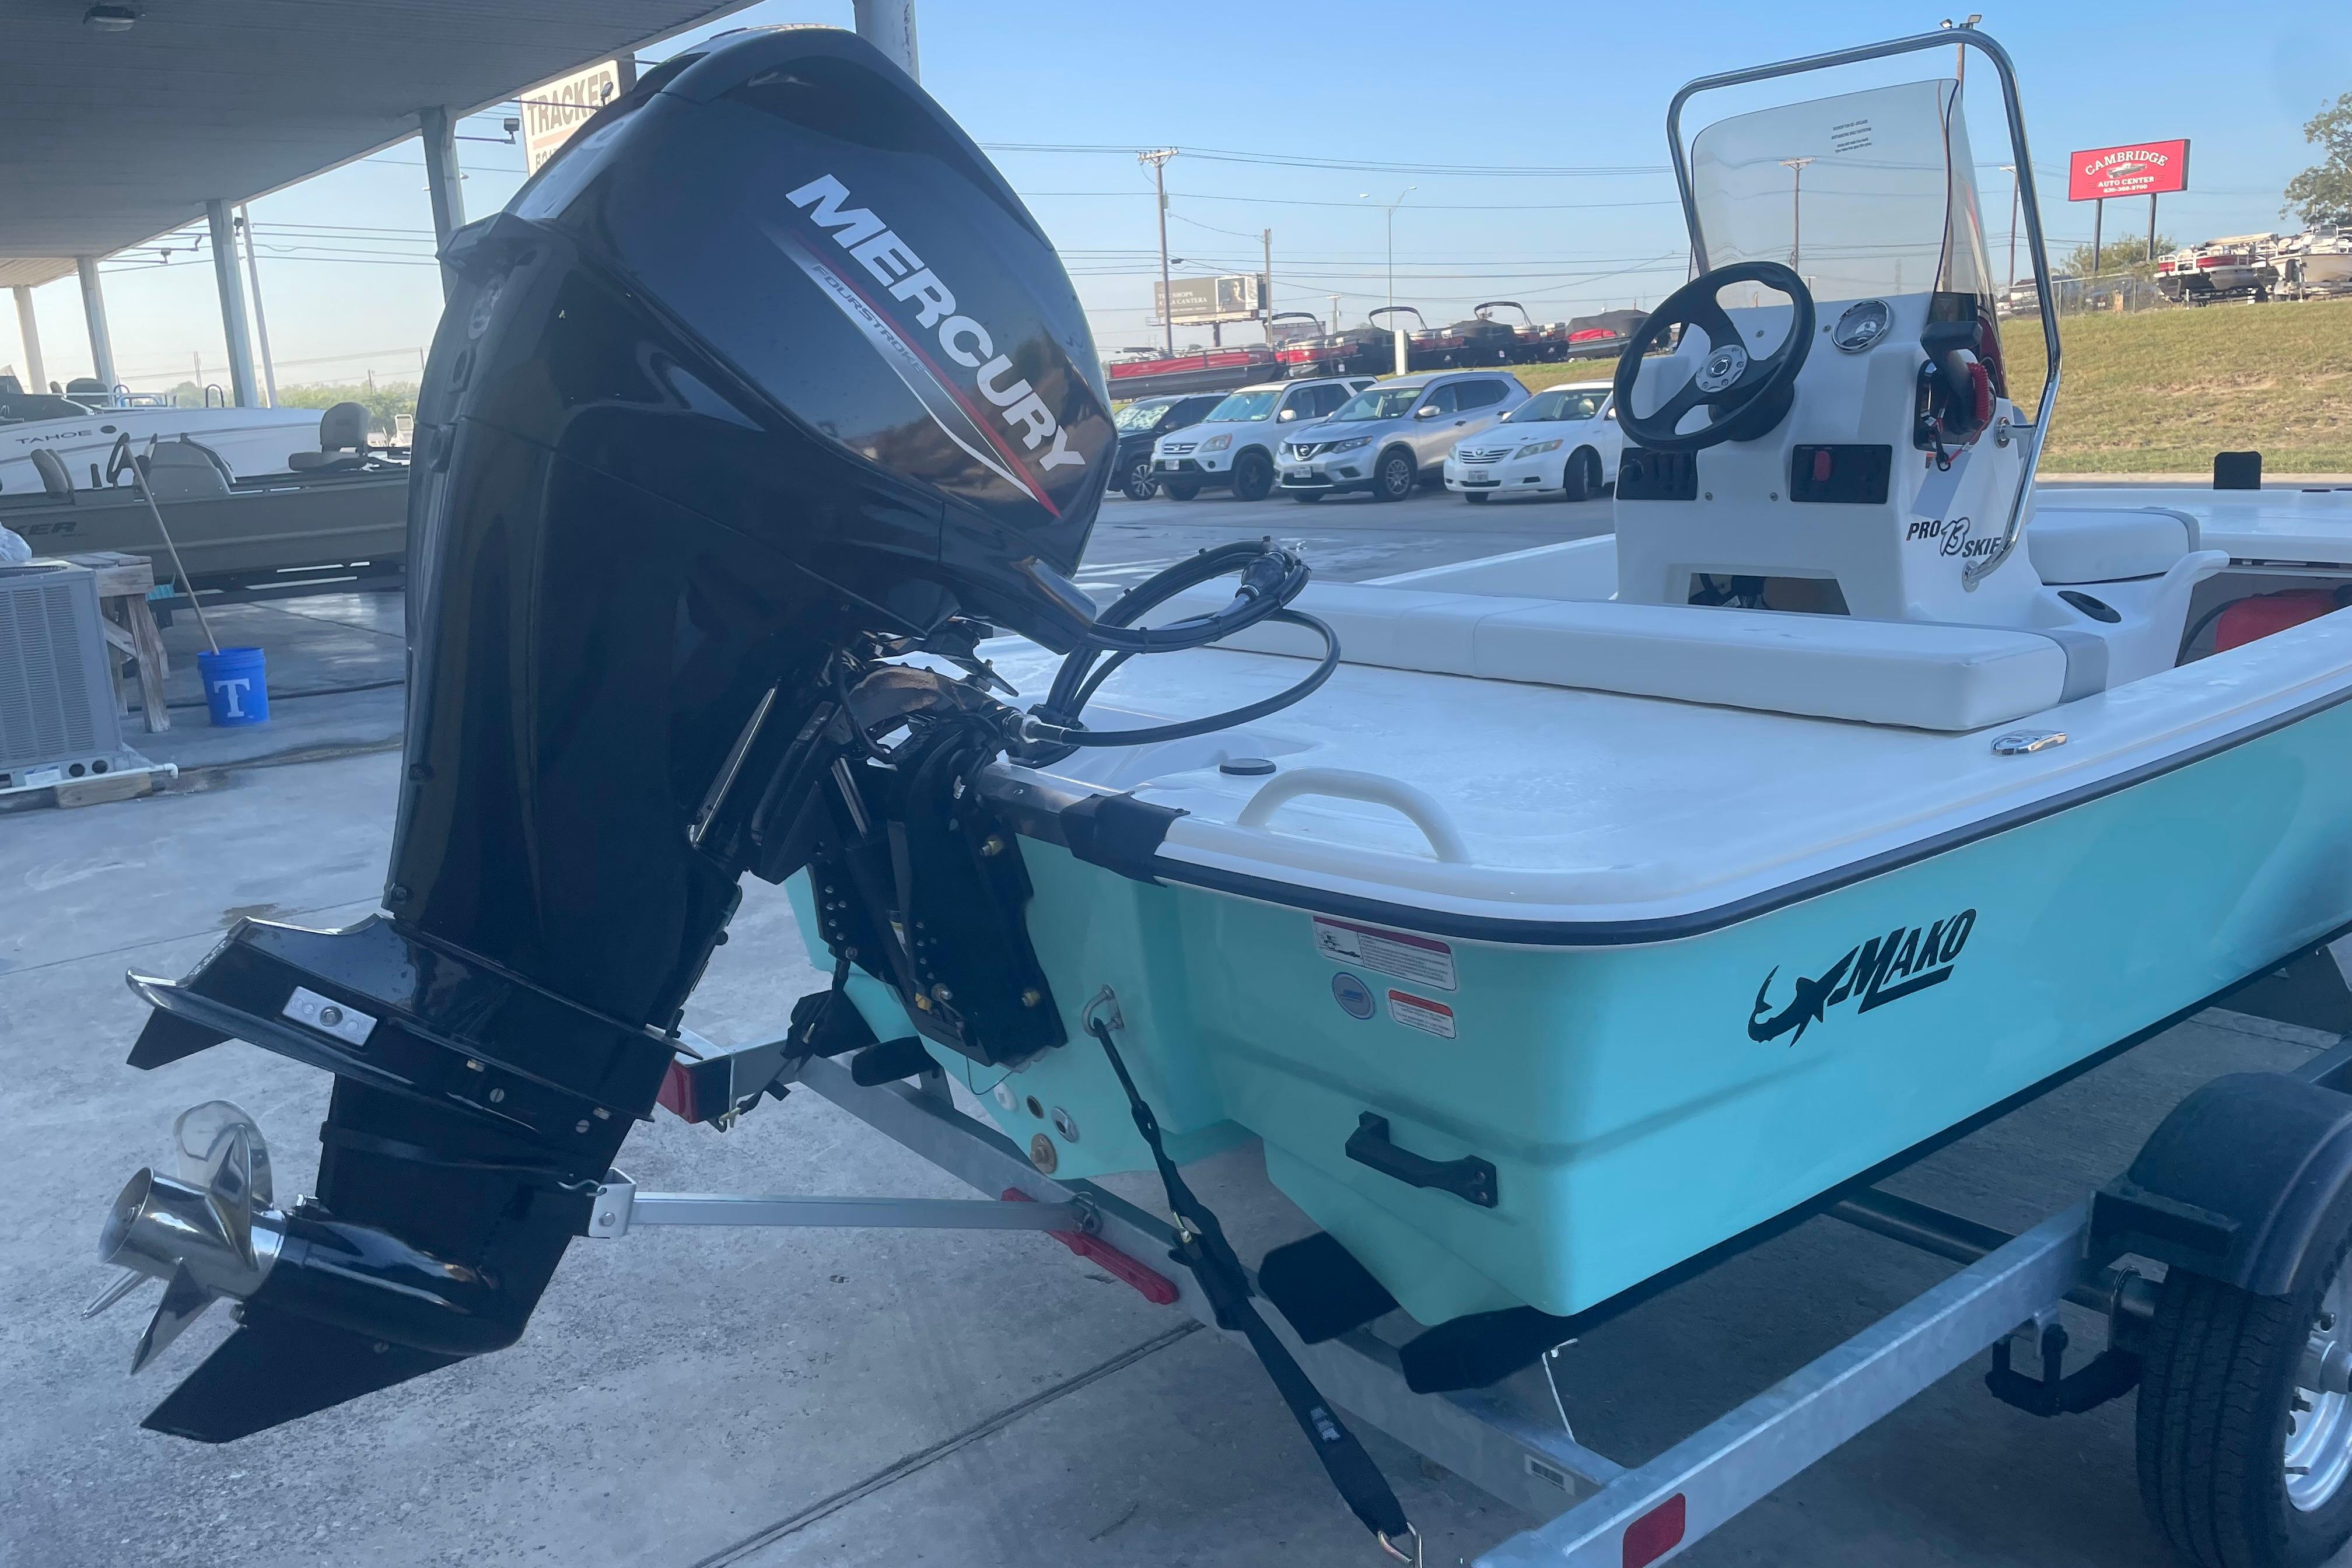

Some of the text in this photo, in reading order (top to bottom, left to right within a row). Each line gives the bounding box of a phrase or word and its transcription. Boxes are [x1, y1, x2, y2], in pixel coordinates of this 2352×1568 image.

[2084, 150, 2169, 176] CAMBRIDGE
[2097, 176, 2155, 188] AUTO CENTER
[785, 174, 1086, 472] MERCURY
[813, 263, 925, 372] FOURSTROKE
[15, 429, 92, 444] TAHOE
[1906, 516, 2002, 558] PRO 13 SKIF
[213, 677, 251, 718] T
[1826, 908, 1978, 1015] MAKO
